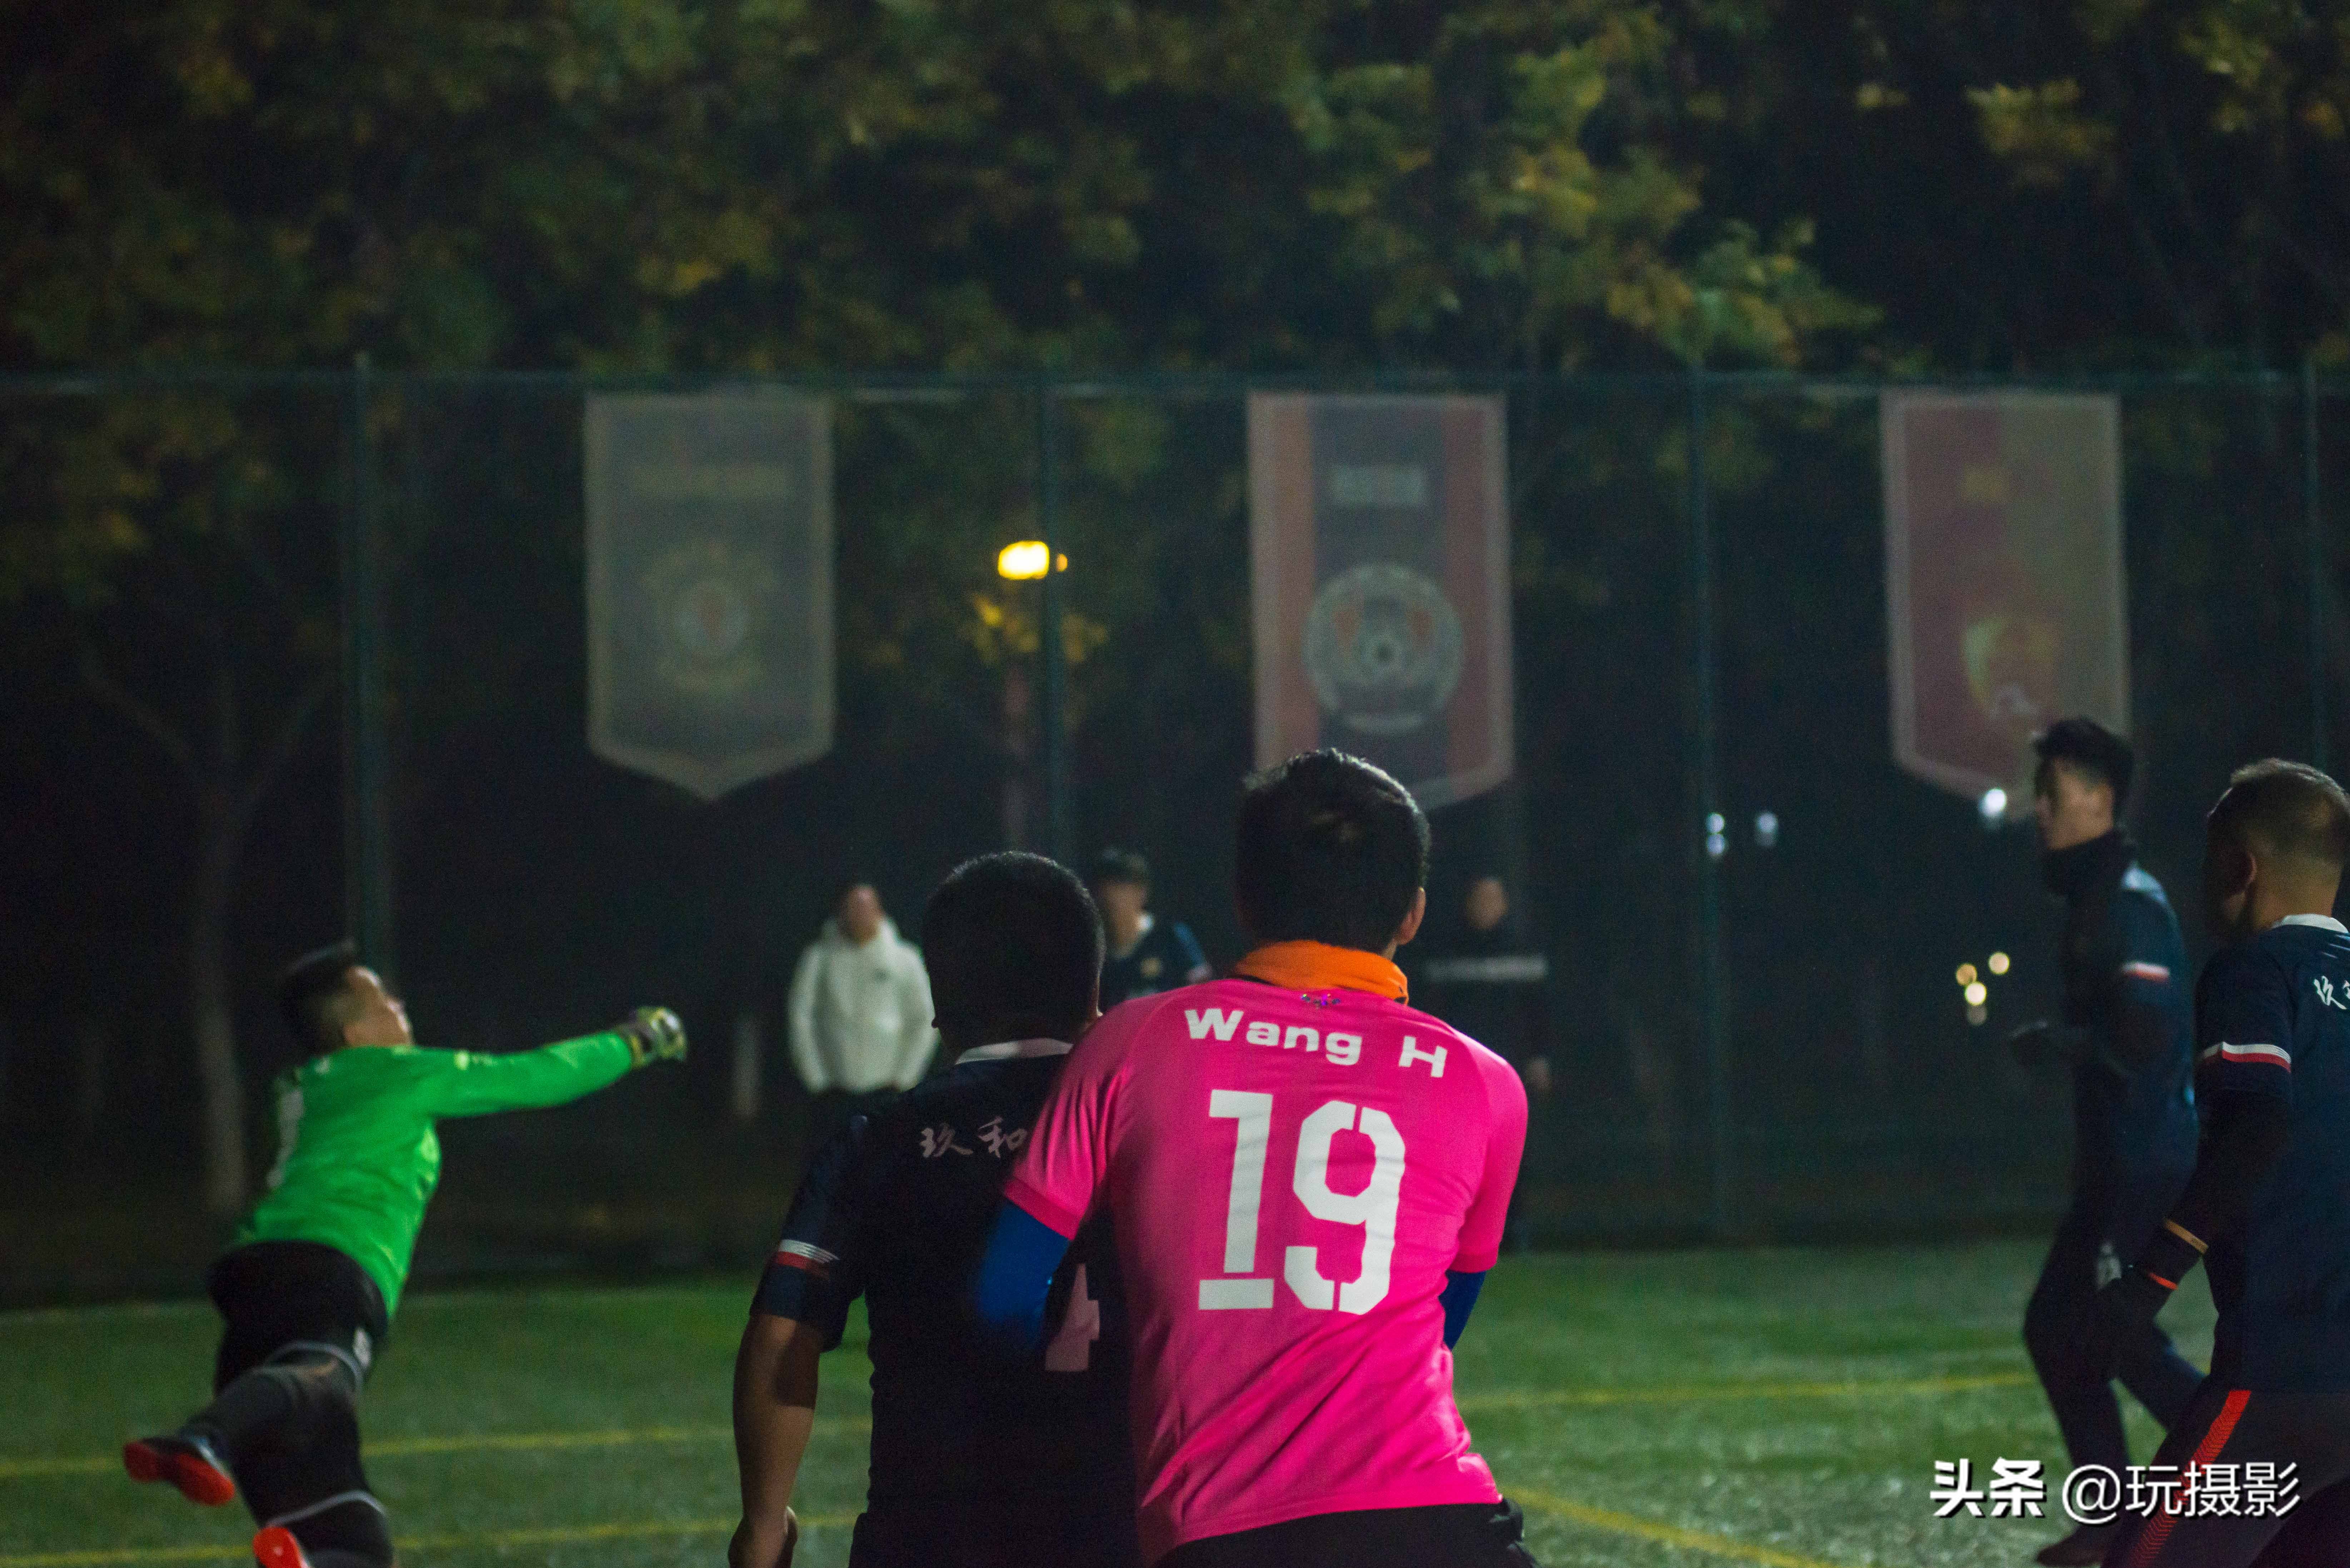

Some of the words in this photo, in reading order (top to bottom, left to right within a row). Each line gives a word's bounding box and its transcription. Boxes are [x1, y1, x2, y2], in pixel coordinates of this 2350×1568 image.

[1185, 1008, 1362, 1066] Wang
[1398, 1035, 1447, 1078] H
[1198, 1089, 1406, 1315] 19
